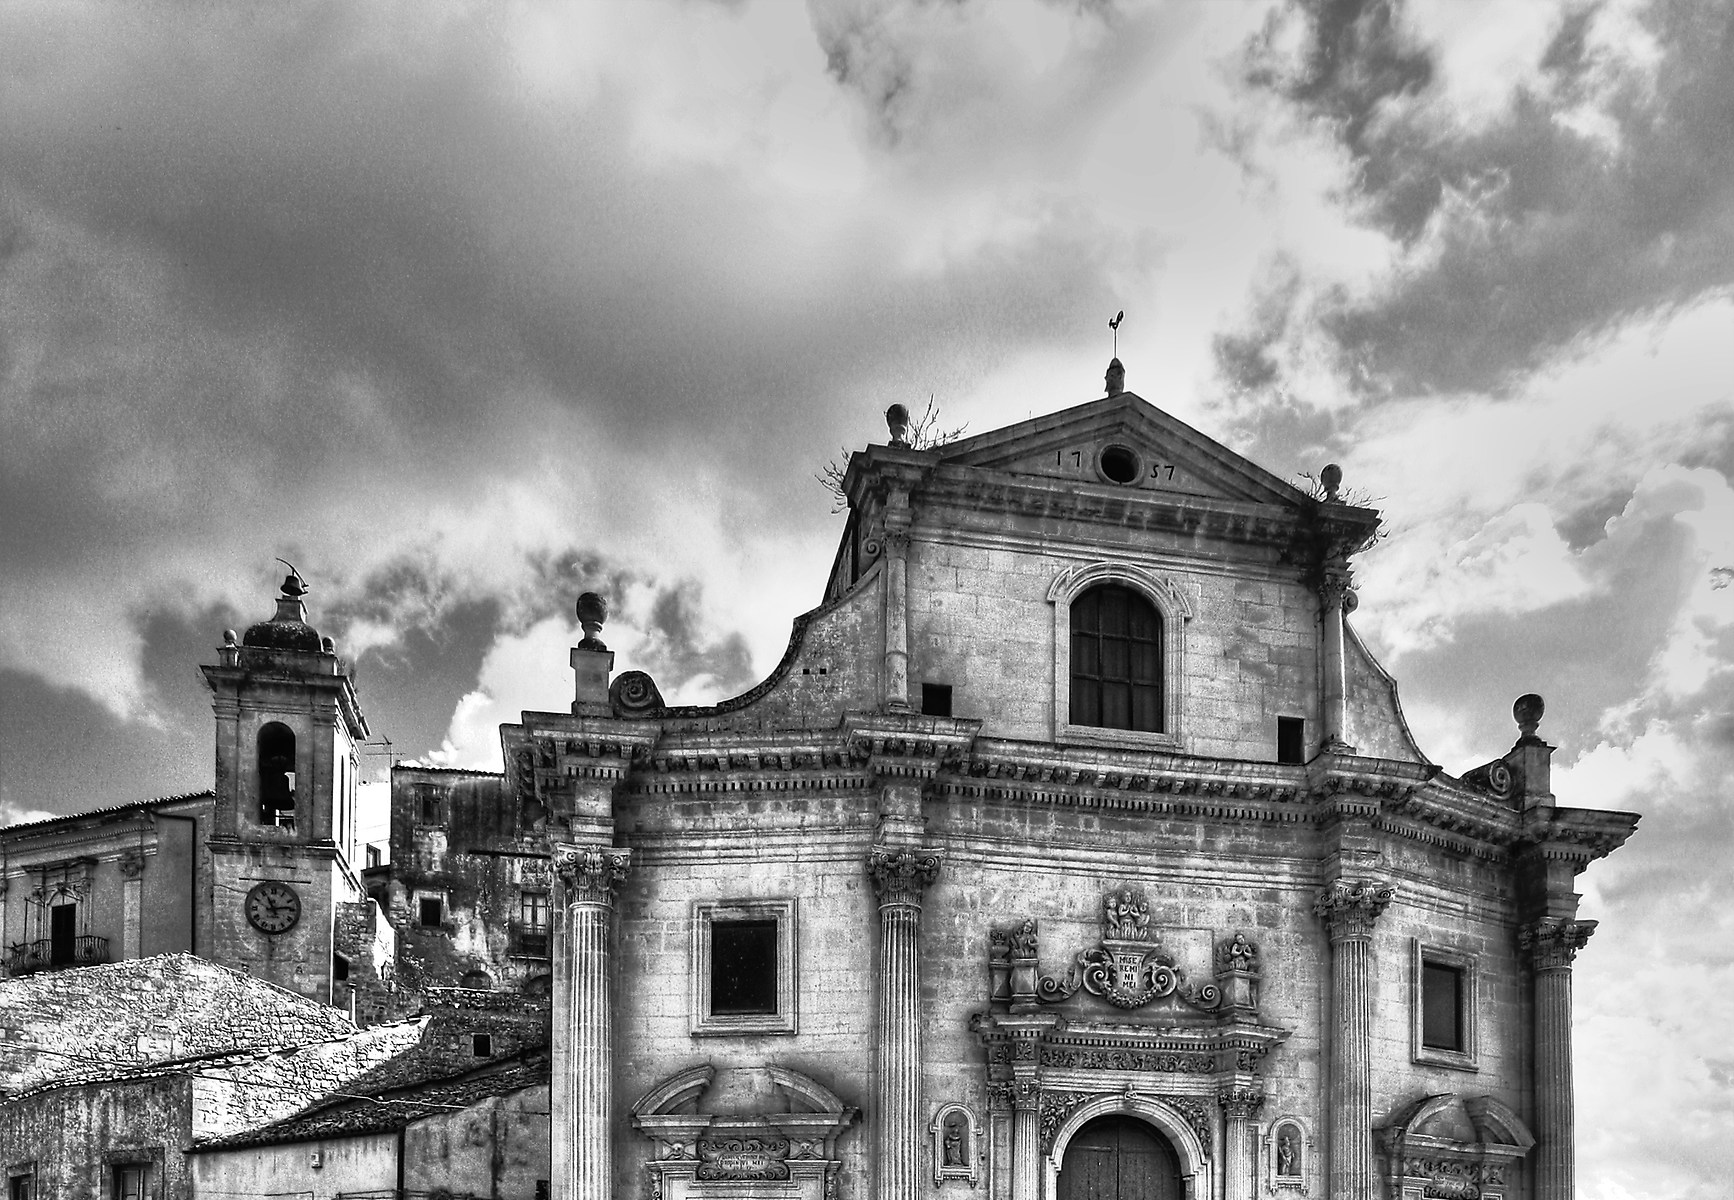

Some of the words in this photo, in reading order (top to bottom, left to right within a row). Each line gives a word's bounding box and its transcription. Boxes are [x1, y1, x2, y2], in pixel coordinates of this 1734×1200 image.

[1057, 450, 1081, 468] 17
[1119, 955, 1138, 965] MISE
[1119, 965, 1138, 973] REMI
[1124, 973, 1134, 981] NI
[1122, 981, 1136, 989] MEI
